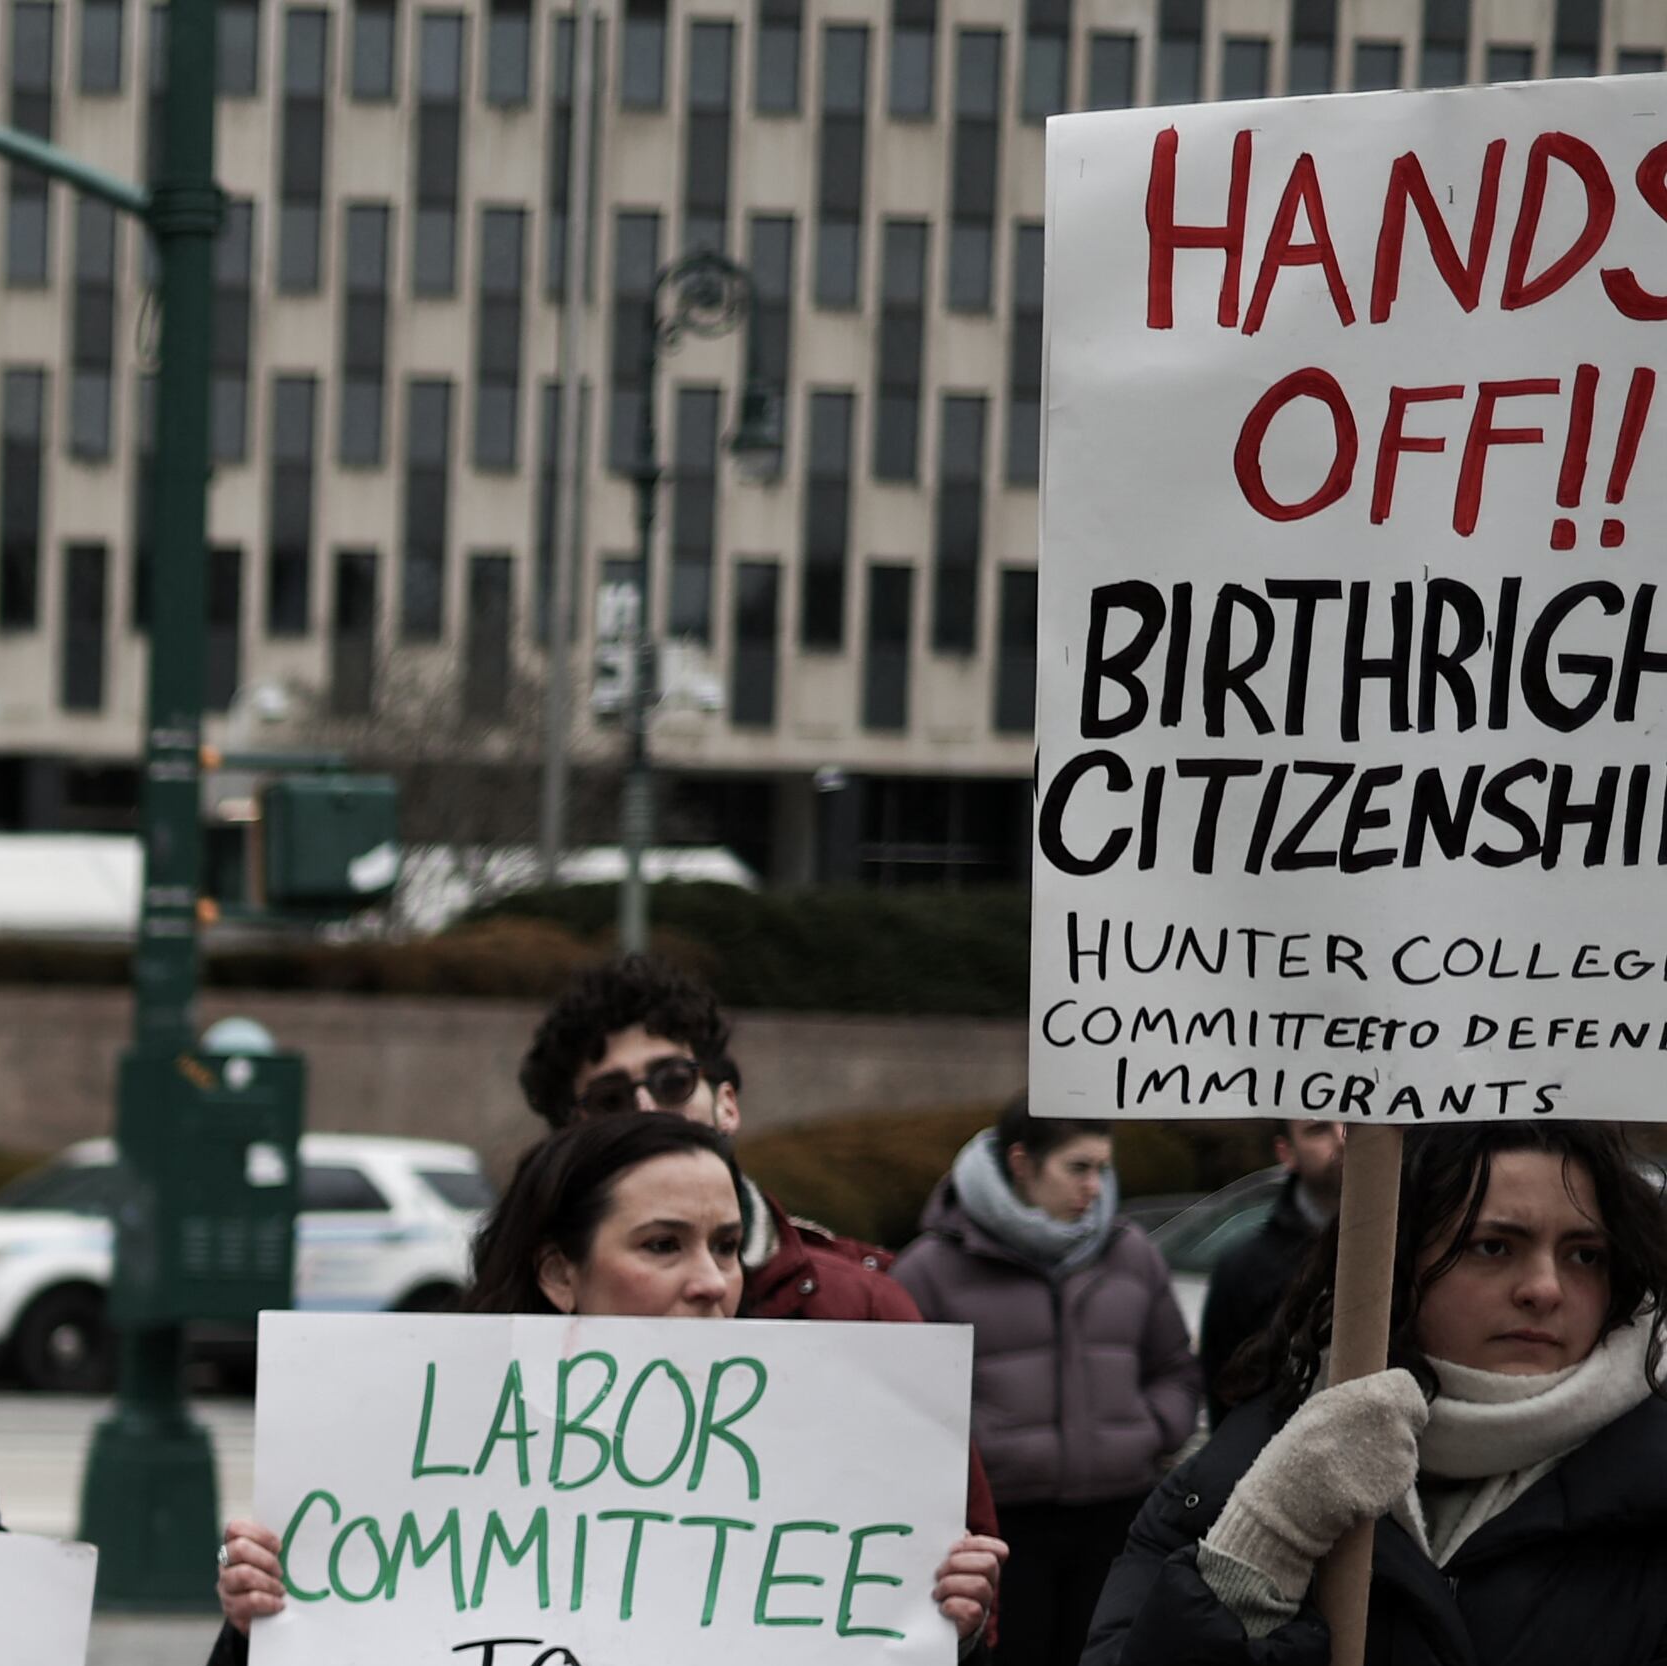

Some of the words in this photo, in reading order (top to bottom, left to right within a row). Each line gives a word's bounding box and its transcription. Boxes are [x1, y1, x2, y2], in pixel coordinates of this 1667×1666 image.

[1236, 365, 1656, 549] OFF!!
[1039, 750, 1667, 876] CITIZENSHI
[1068, 912, 1367, 983] HUNTER
[1392, 936, 1667, 985] COLLEG
[1118, 1057, 1562, 1119] IMMIGRANTS
[1463, 1015, 1667, 1050] DEFEN
[412, 1351, 767, 1501] LABOR
[280, 1489, 913, 1639] COMMITTEE
